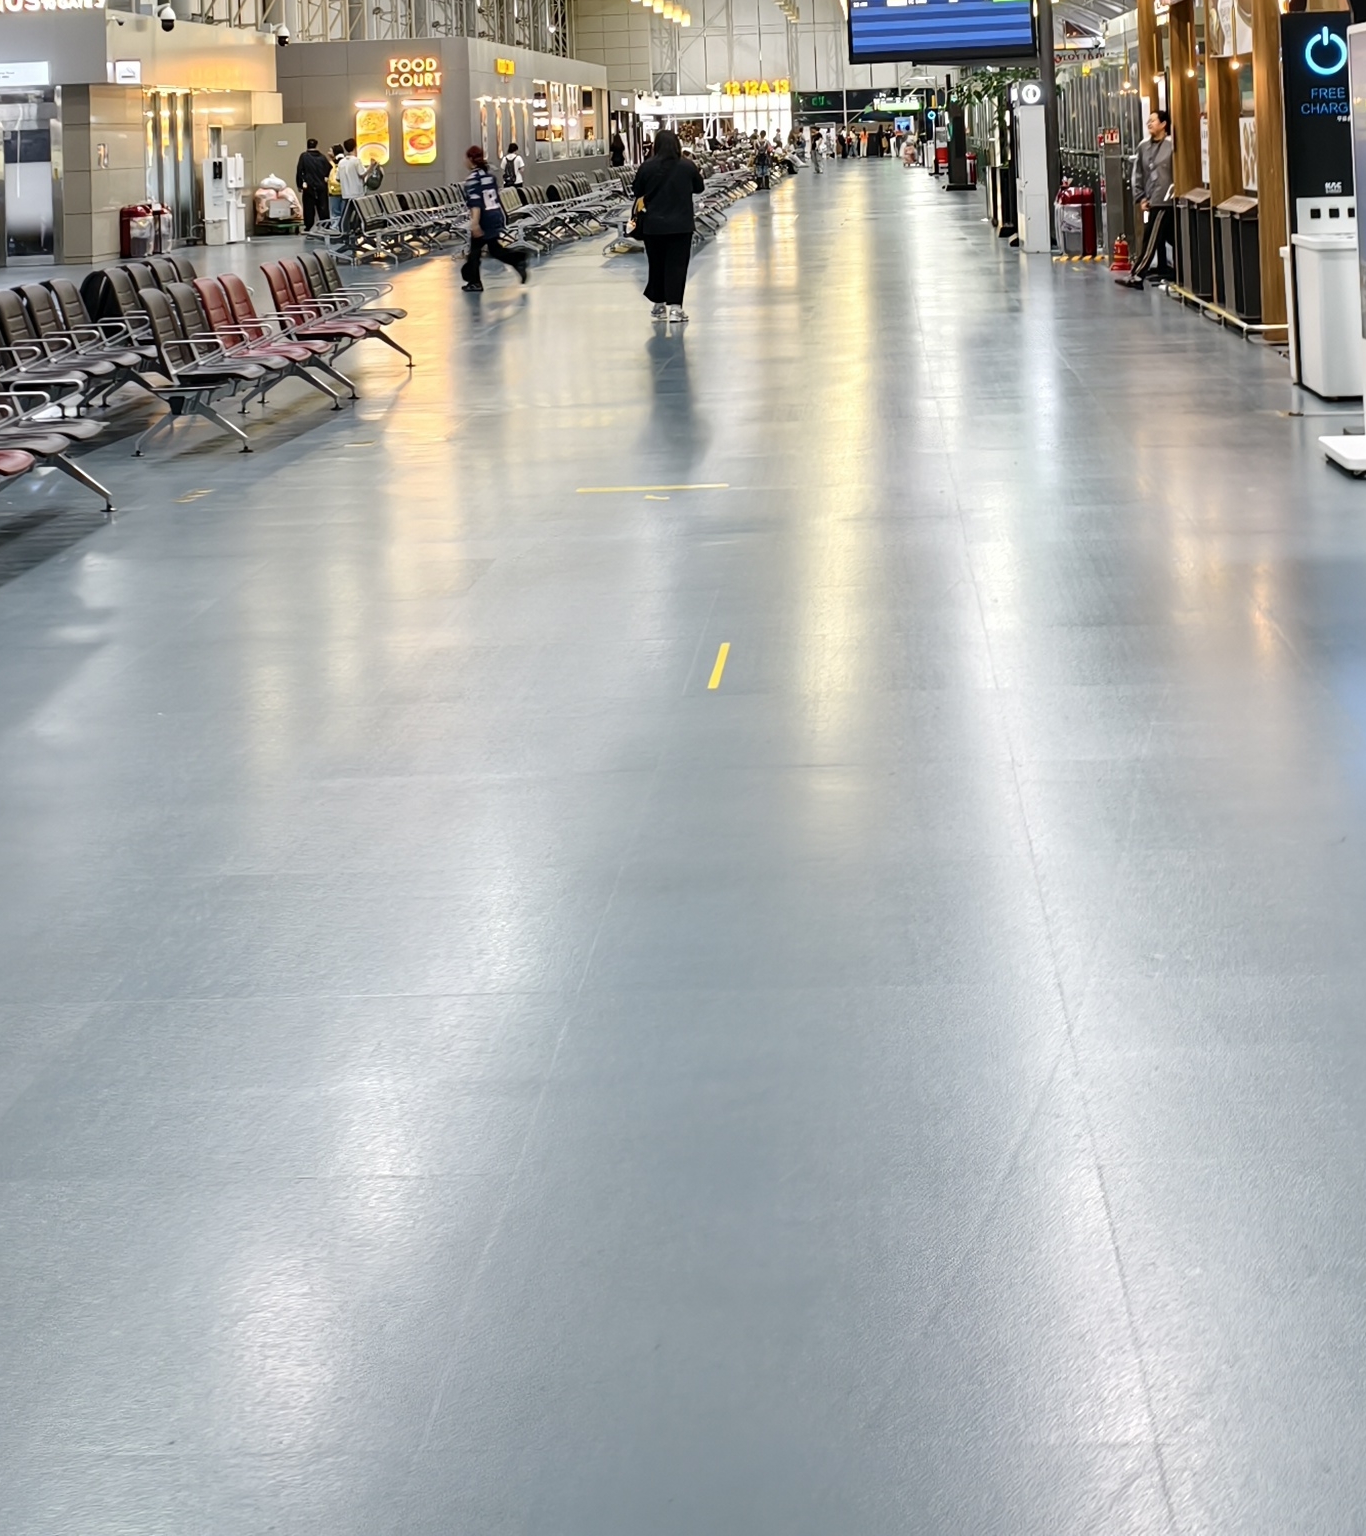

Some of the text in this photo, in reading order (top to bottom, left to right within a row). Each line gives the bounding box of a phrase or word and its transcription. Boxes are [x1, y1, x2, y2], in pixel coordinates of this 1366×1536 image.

[389, 57, 437, 73] FOOD
[386, 72, 442, 88] COURT
[724, 79, 790, 96] 12 12A 13
[1311, 87, 1346, 99] FREE
[1301, 102, 1349, 115] CHARG
